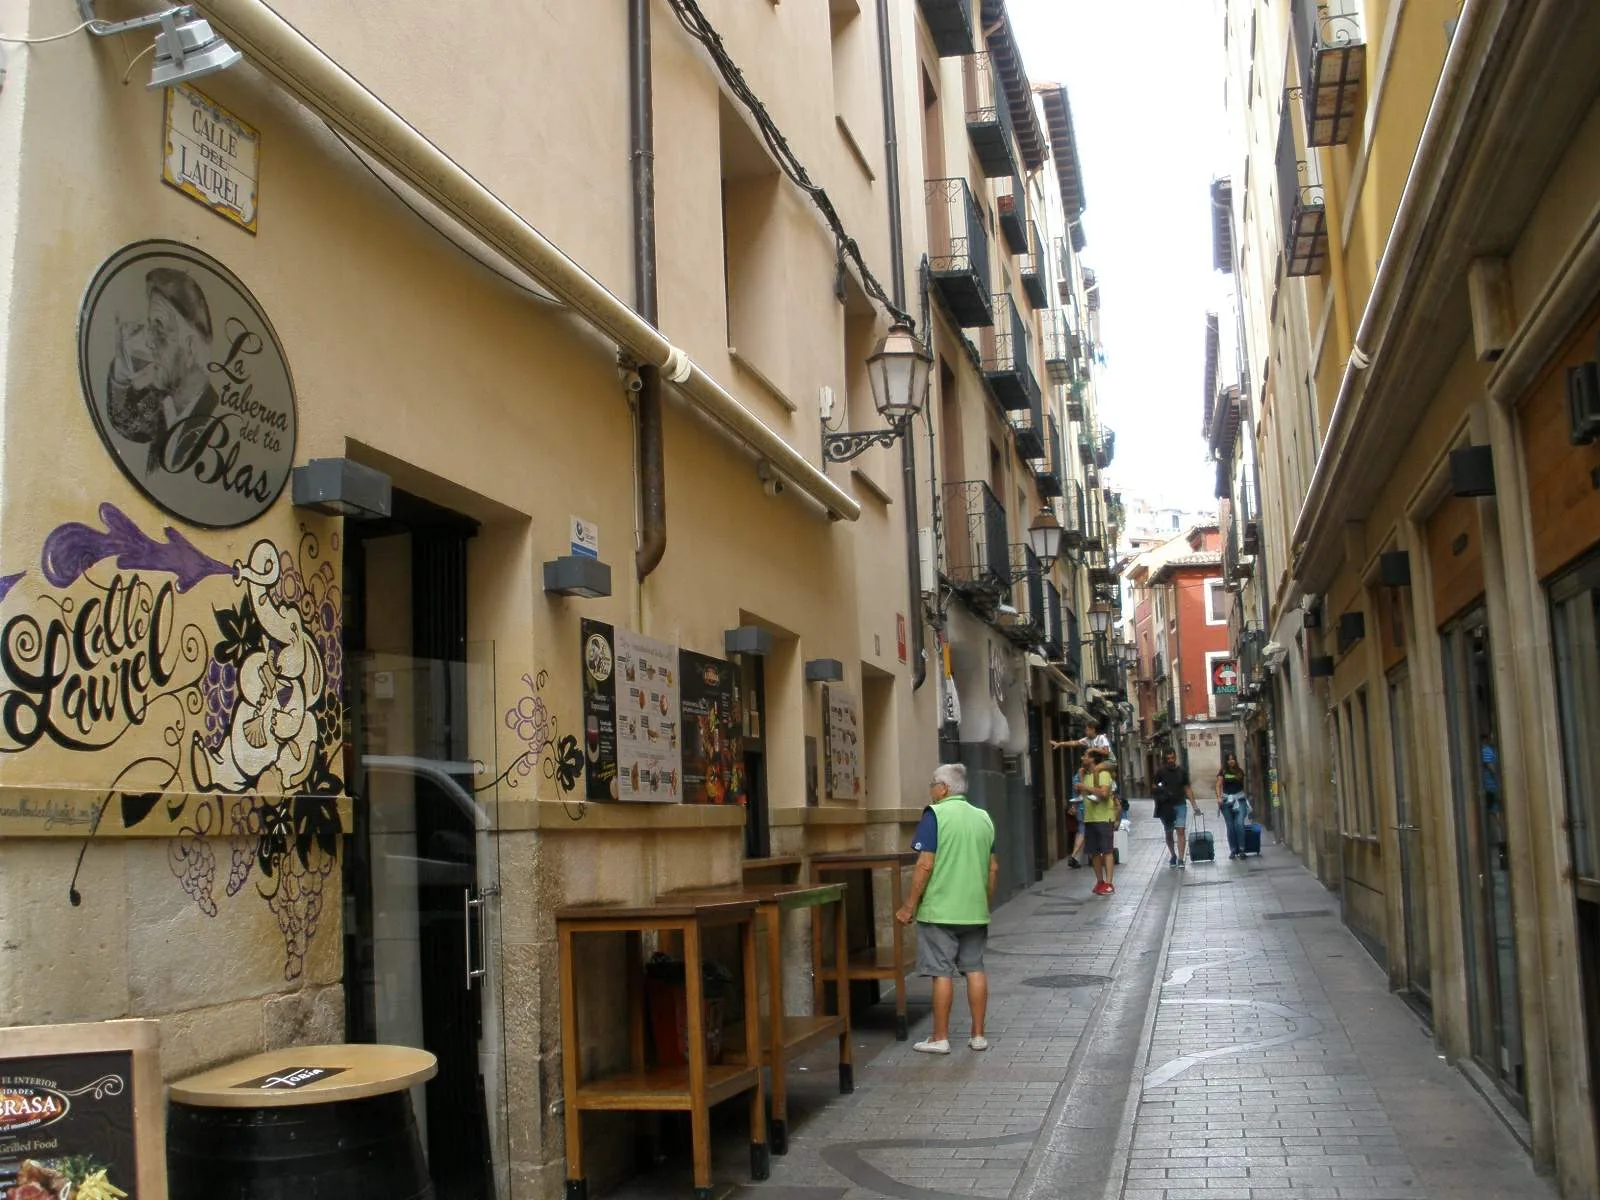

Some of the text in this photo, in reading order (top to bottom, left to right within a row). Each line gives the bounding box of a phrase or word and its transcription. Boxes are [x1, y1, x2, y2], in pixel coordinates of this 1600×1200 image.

[192, 109, 238, 158] CALLE
[199, 144, 228, 171] DEL
[180, 144, 243, 211] LAUREL
[207, 317, 264, 384] La
[218, 383, 288, 432] taberna
[239, 420, 260, 444] del
[160, 413, 271, 503] Blas
[66, 573, 153, 671] Calle
[0, 580, 180, 752] Laurel
[14, 1076, 57, 1088] INTERIOR
[33, 1138, 58, 1151] Food
